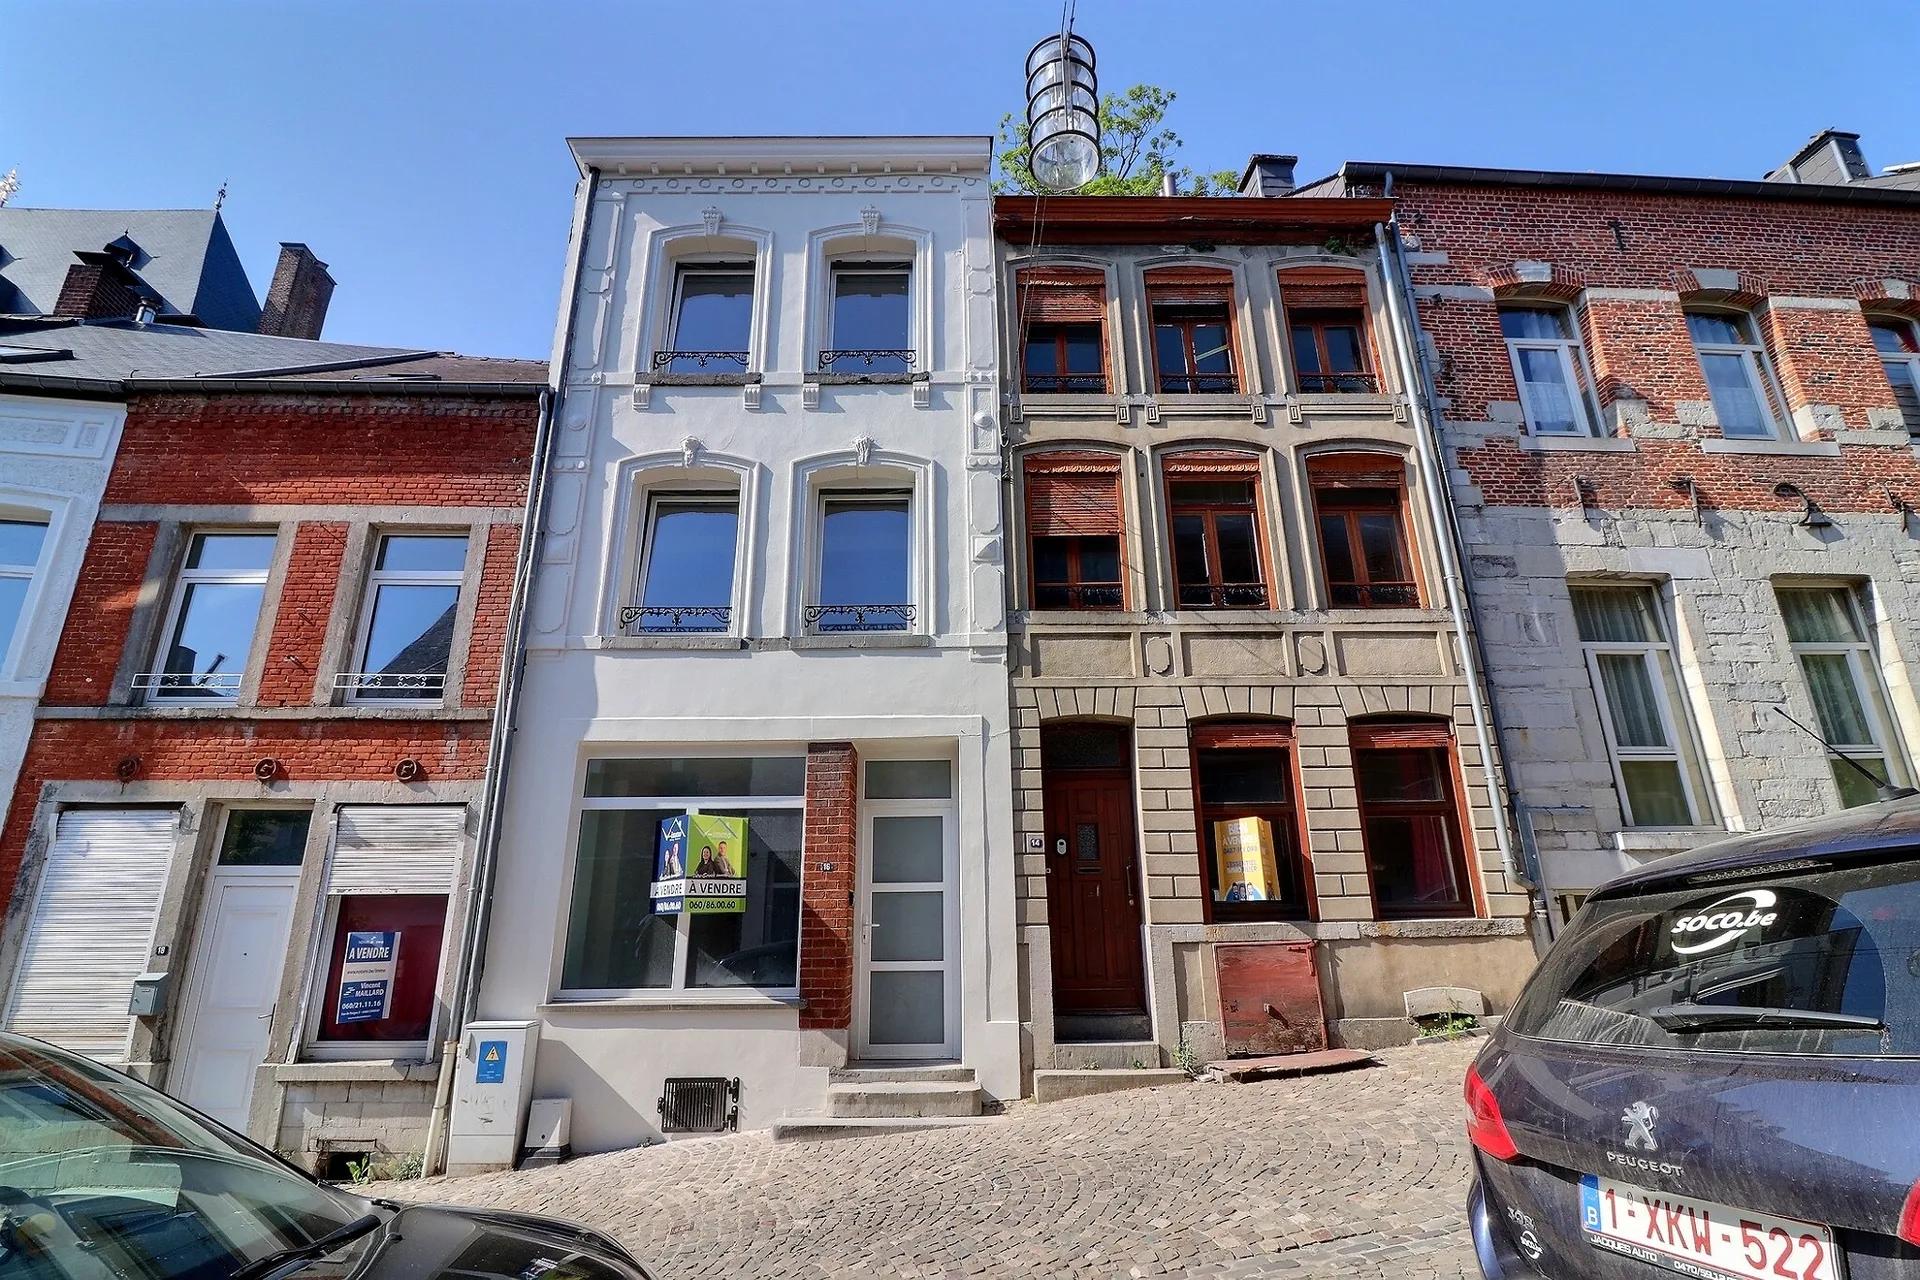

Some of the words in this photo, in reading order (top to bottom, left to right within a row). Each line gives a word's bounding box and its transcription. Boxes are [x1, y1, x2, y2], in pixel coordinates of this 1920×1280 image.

[1031, 839, 1040, 847] 14
[660, 882, 682, 896] VENDRE
[689, 880, 697, 894] À
[700, 883, 742, 894] VENDRE
[689, 900, 736, 911] 060/86.00.60
[157, 946, 166, 955] 18
[348, 947, 355, 960] A
[356, 946, 390, 959] VENDRE
[355, 988, 385, 997] MAILLARD
[341, 1000, 382, 1010] 060/21.11.16
[1607, 1151, 1684, 1177] PEUGEOT
[1588, 1206, 1599, 1226] B
[1590, 1234, 1632, 1255] JACQUES
[1632, 1247, 1658, 1263] AUTO
